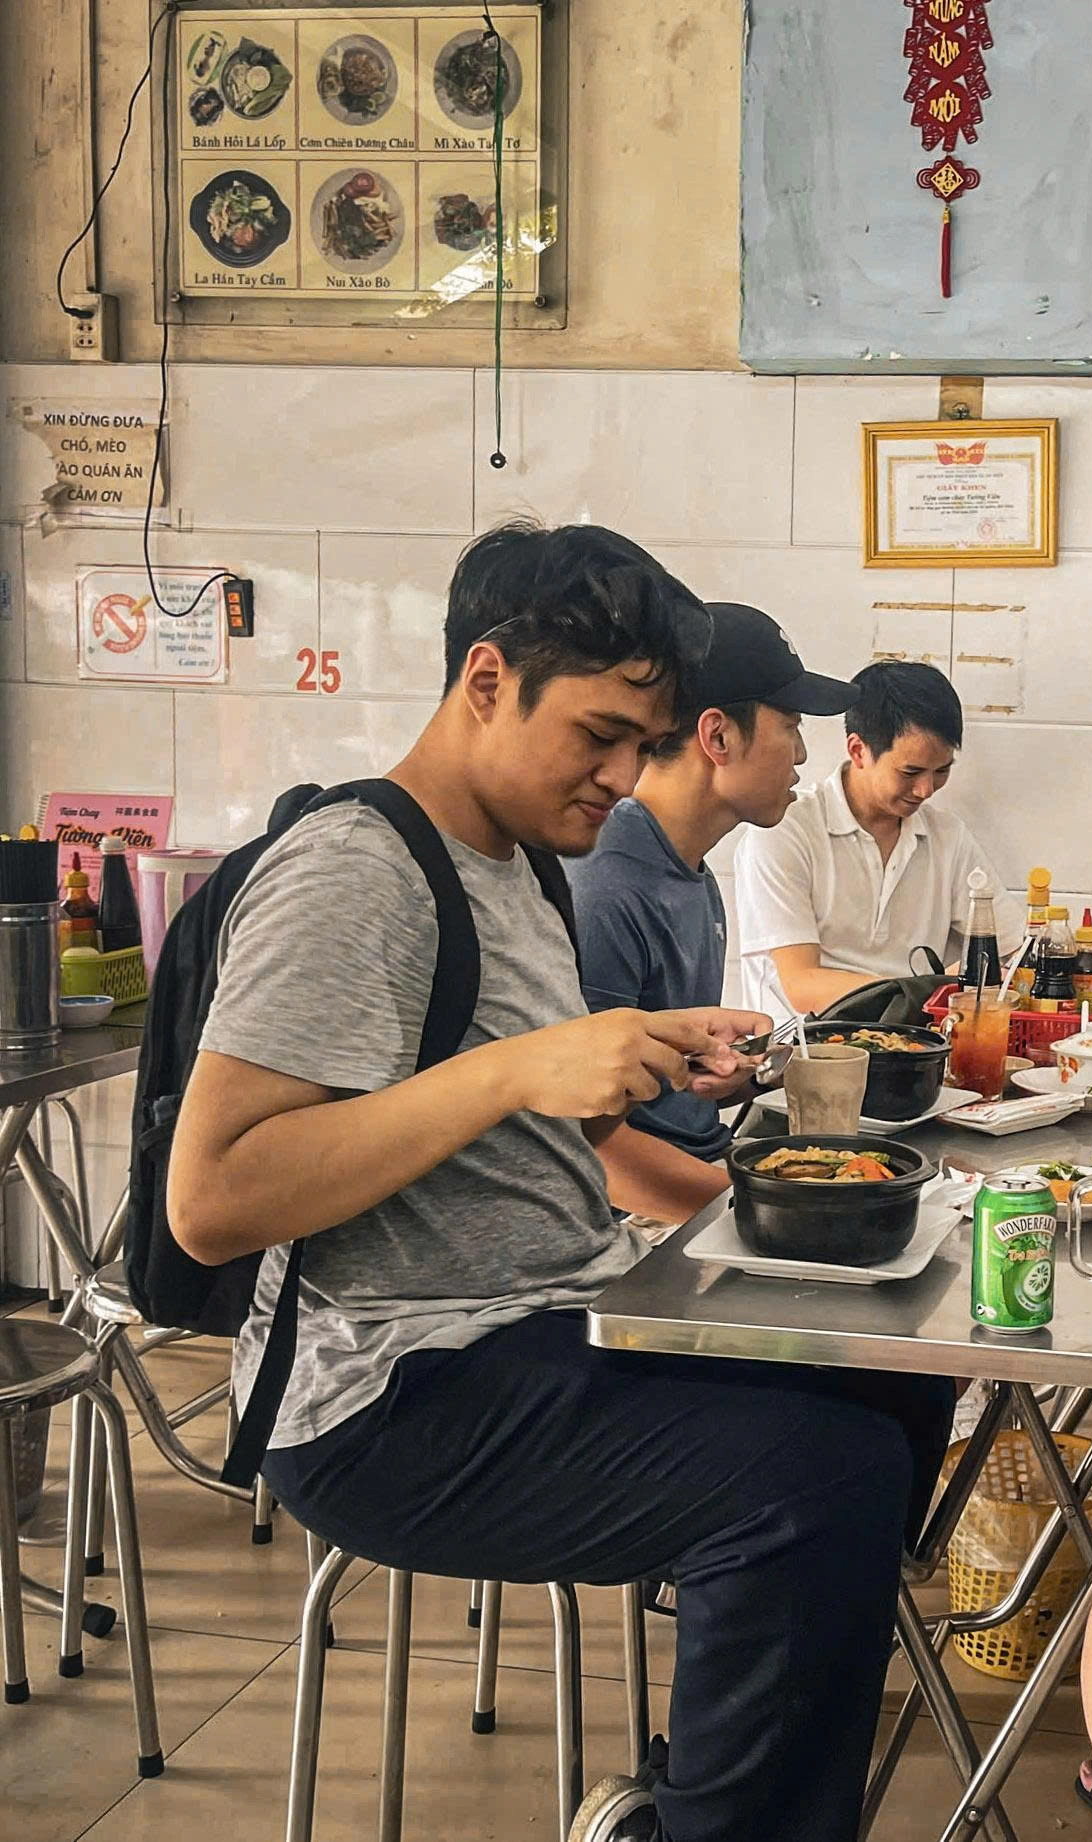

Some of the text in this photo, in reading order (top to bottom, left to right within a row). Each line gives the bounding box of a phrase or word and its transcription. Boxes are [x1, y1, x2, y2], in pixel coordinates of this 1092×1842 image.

[192, 135, 220, 147] Bánh
[247, 135, 261, 147] Lá
[195, 273, 208, 284] La
[237, 273, 256, 288] Tay
[375, 276, 390, 288] Bò
[44, 411, 144, 429] XIN ĐỪNG ĐƯA
[61, 436, 127, 454] CHÓ, MÈO
[82, 462, 121, 478] QUÁN
[101, 489, 123, 503] ƠN
[296, 648, 341, 693] 25
